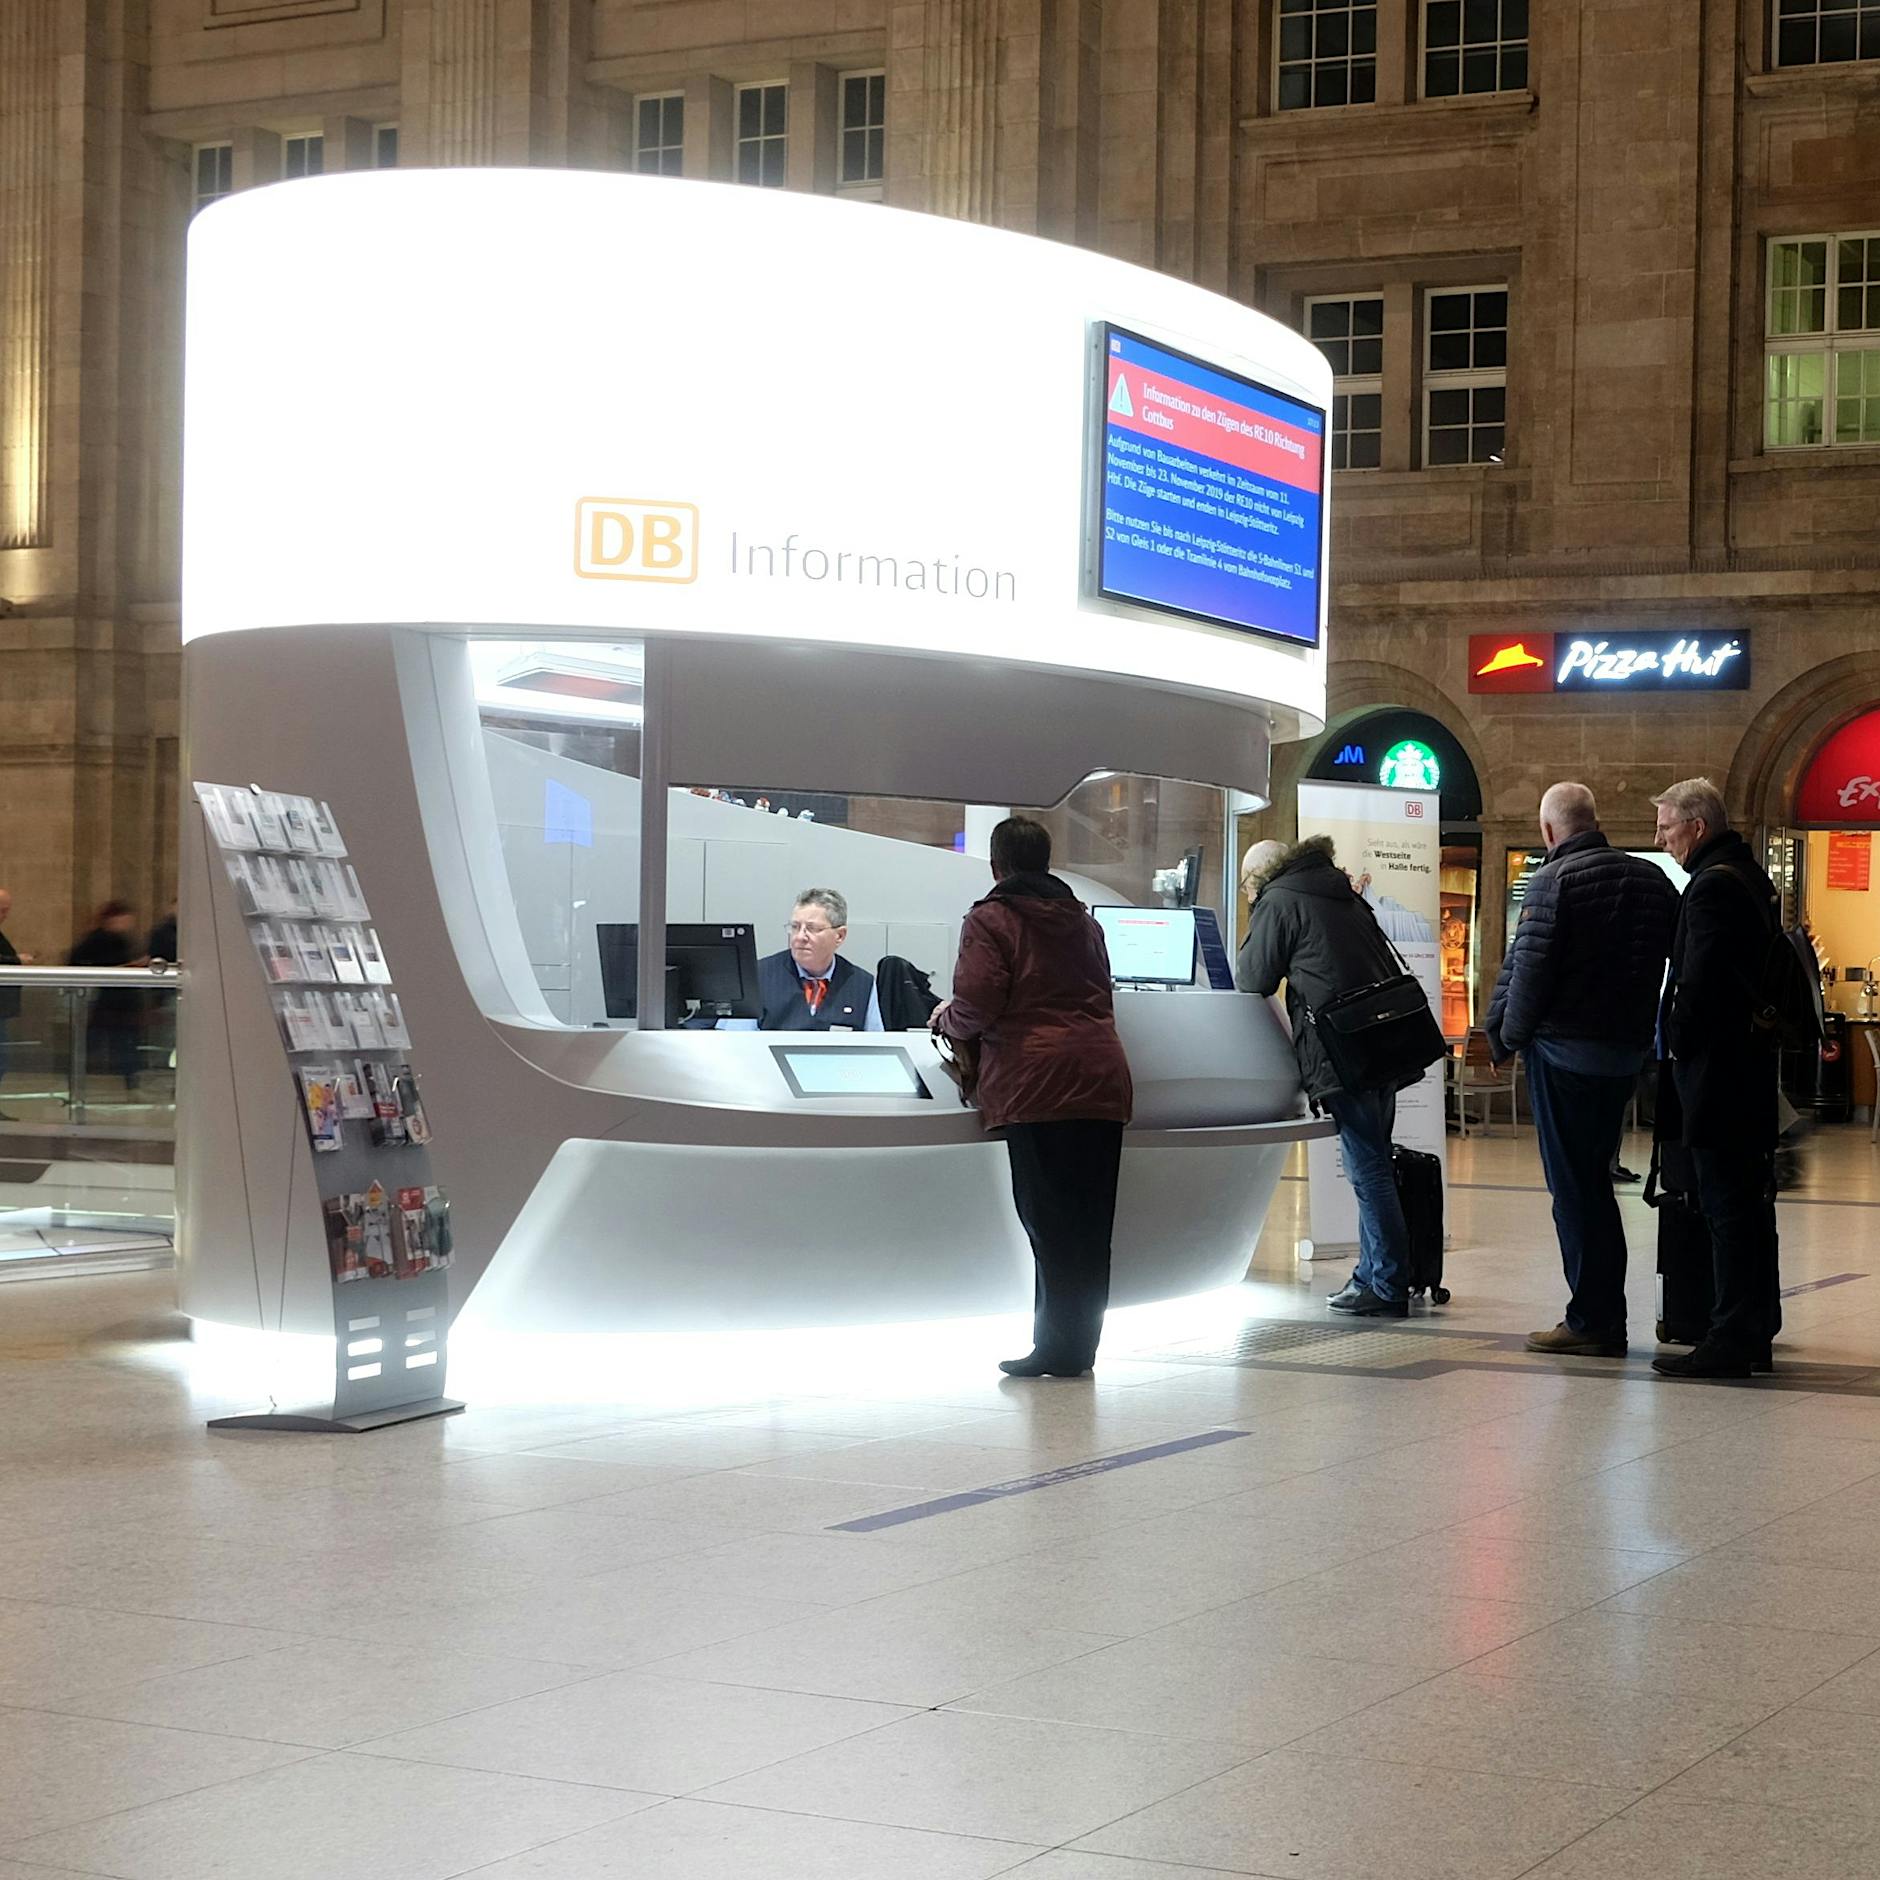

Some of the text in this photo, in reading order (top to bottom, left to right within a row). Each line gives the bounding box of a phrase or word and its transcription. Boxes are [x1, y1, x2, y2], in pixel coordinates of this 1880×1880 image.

[1143, 406, 1174, 430] Cottbus
[1144, 383, 1304, 459] Information zu den Zügen des RE10 Richtung
[1107, 471, 1122, 487] Hbf.
[1124, 476, 1136, 490] Die
[1138, 480, 1155, 498] Züge
[1157, 488, 1181, 504] starten
[1182, 497, 1195, 509] und
[1196, 501, 1217, 515] enden
[1218, 506, 1225, 518] in
[1108, 434, 1141, 455] Aufgrund
[1143, 448, 1156, 460] von
[1157, 450, 1198, 474] Bauarbeiten
[1199, 464, 1226, 482] verkehrt
[1227, 474, 1236, 486] im
[1280, 492, 1290, 505] 11.
[1108, 453, 1144, 475] November
[1146, 464, 1156, 479] bis
[1158, 468, 1169, 482] 23.
[1171, 472, 1205, 494] November
[1206, 484, 1223, 500] 2019
[1224, 491, 1235, 504] der
[1236, 494, 1253, 510] RE10
[1283, 509, 1304, 528] Leipzig
[588, 510, 685, 570] DB
[1105, 527, 1115, 540] S2
[1116, 532, 1129, 544] von
[1131, 534, 1149, 548] Gleis
[1150, 540, 1155, 552] 1
[1156, 543, 1173, 556] oder
[1174, 546, 1185, 559] die
[1217, 559, 1222, 570] 4
[1224, 563, 1238, 574] vom
[1106, 507, 1124, 524] Bitte
[1125, 516, 1150, 531] nutzen
[1151, 520, 1162, 535] Sie
[1163, 524, 1173, 538] bis
[1175, 529, 1191, 543] nach
[1247, 550, 1257, 563] die
[731, 531, 1016, 601] Information
[1557, 638, 1742, 684] Pizza Hut
[1374, 850, 1411, 859] Westseite
[1388, 862, 1408, 871] Halle
[1410, 864, 1432, 874] fertig.
